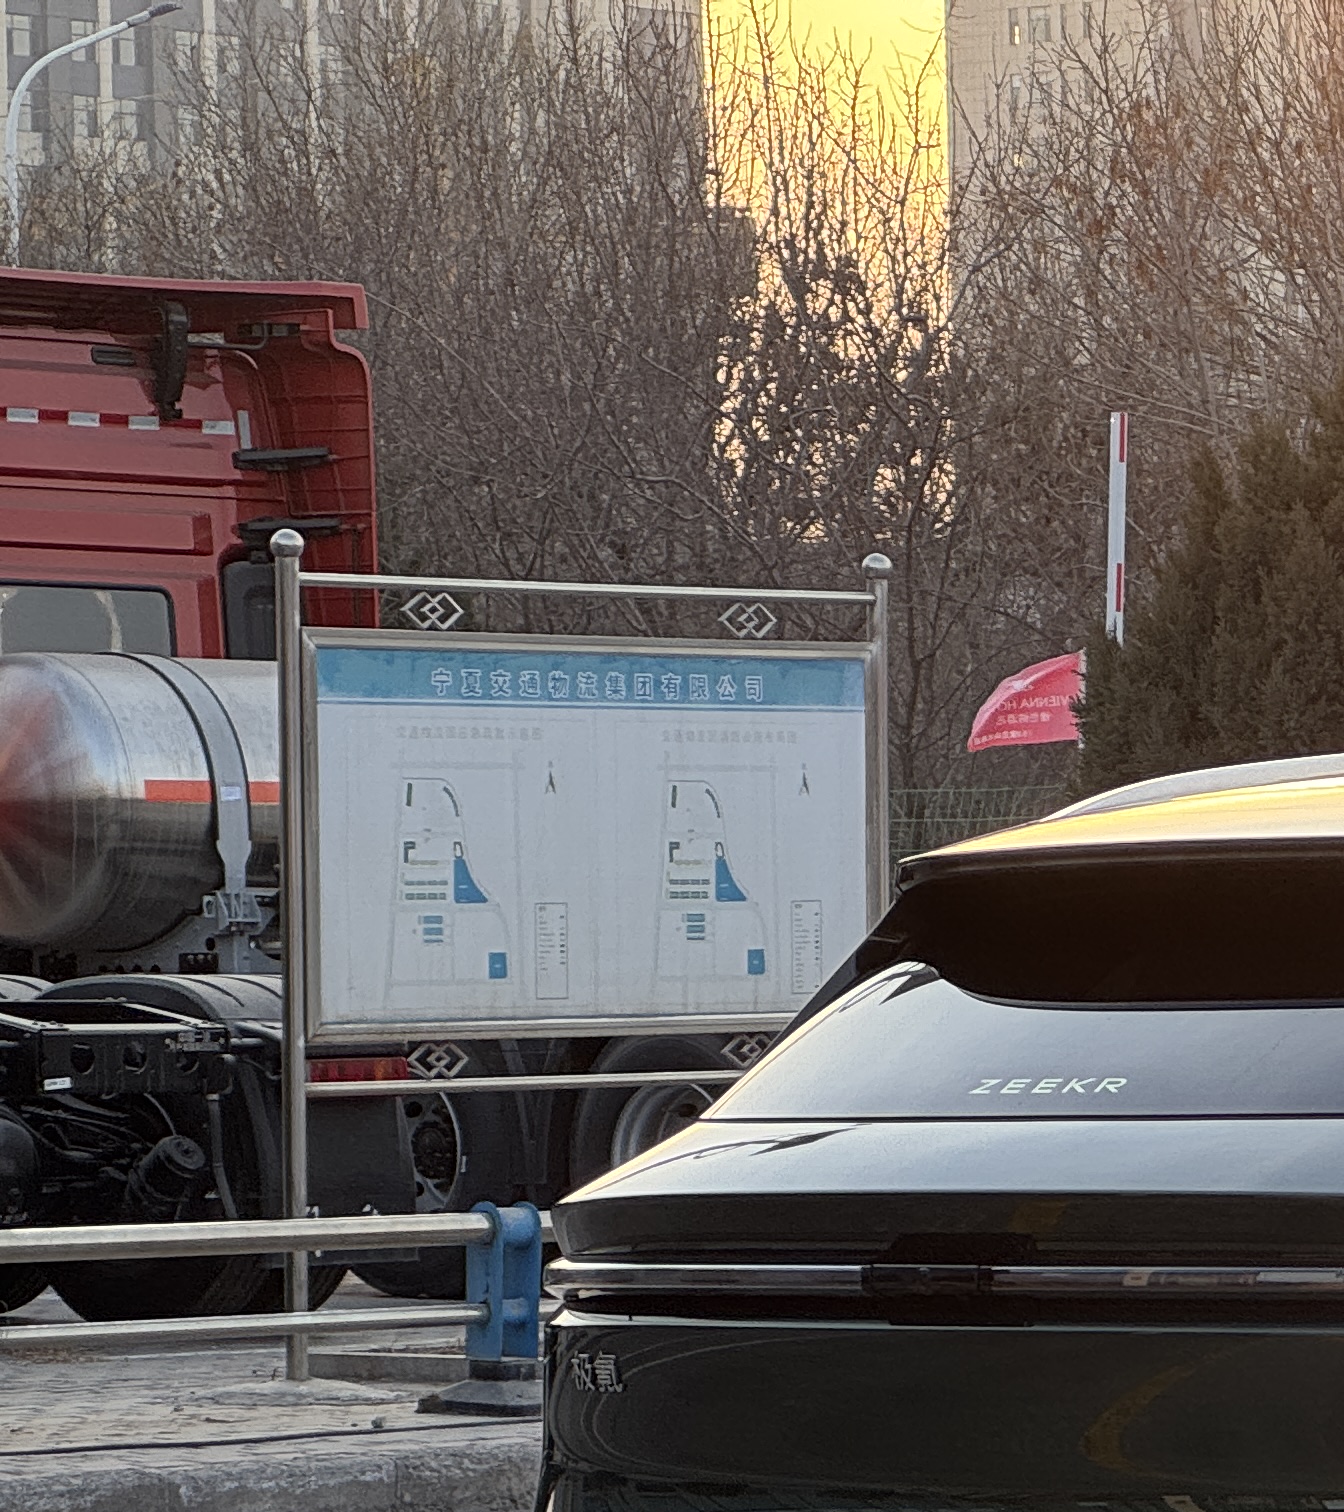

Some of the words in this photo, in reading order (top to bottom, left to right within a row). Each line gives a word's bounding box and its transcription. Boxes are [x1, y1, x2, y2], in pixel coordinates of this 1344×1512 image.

[431, 667, 763, 702] 宁夏交通物流集团有限公司
[968, 1077, 1128, 1095] ZEEKR
